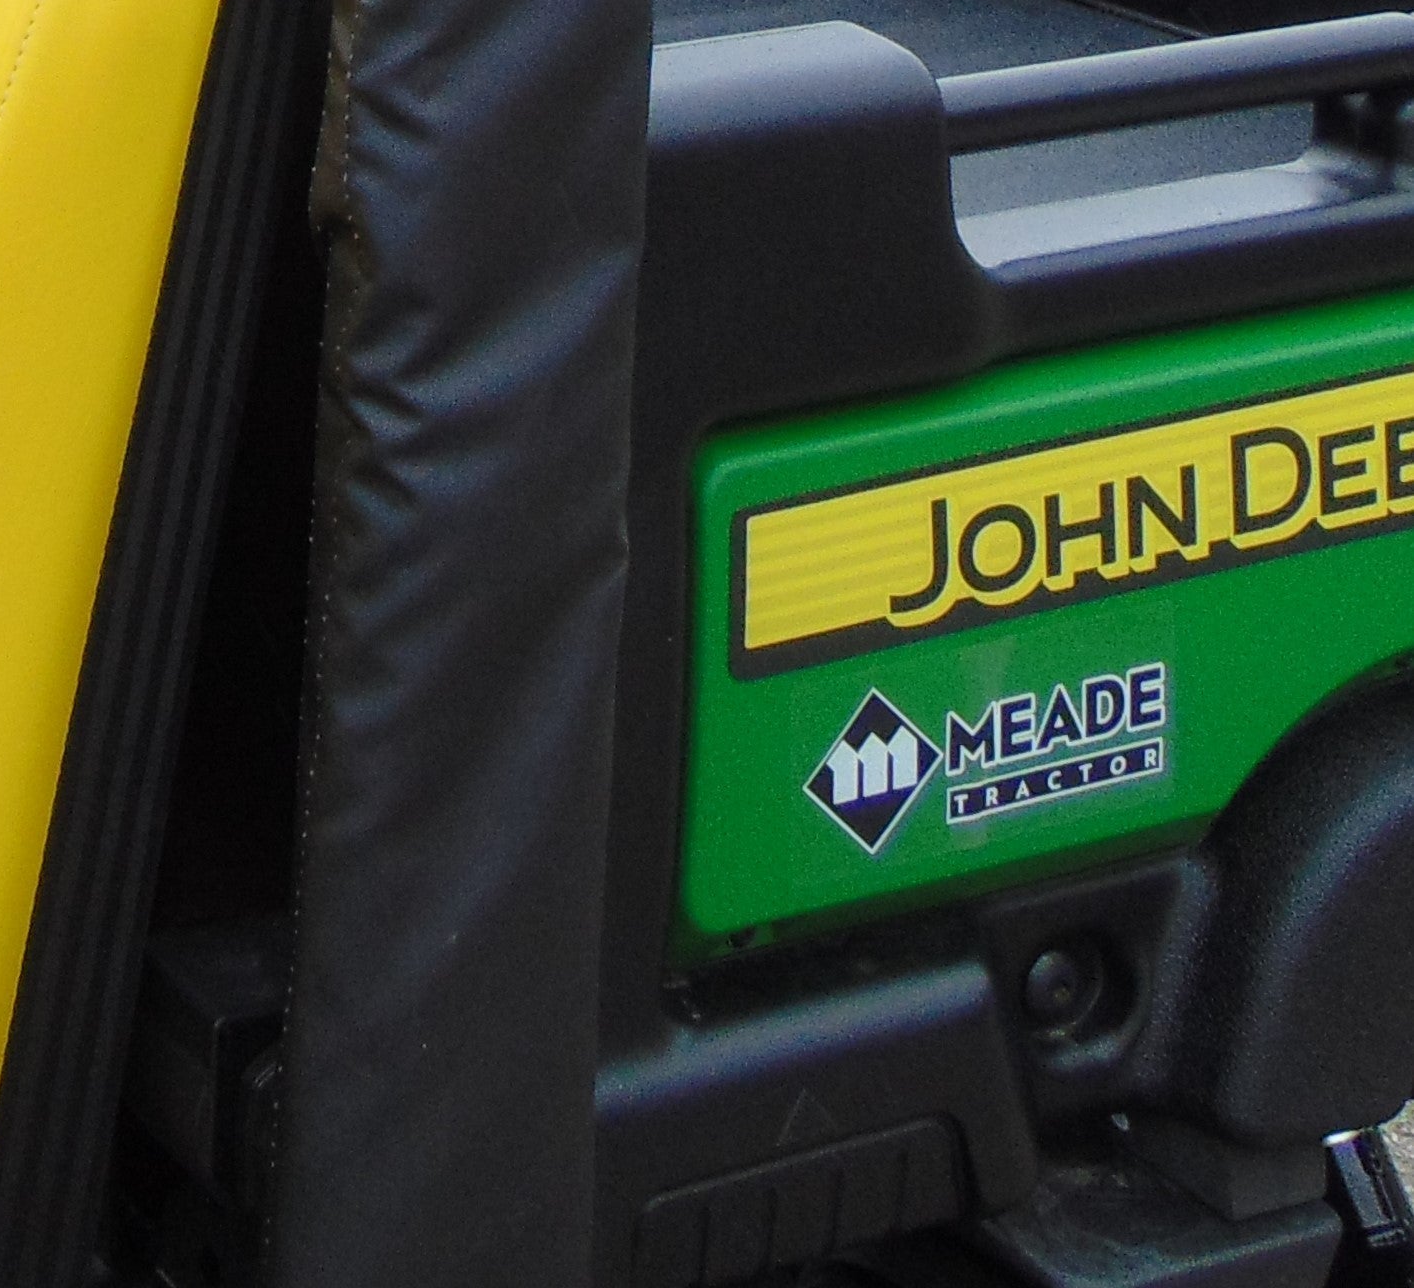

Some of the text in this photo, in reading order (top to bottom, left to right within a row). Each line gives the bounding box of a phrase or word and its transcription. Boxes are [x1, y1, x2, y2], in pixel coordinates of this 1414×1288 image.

[889, 464, 1197, 614] JOHN
[945, 662, 1165, 776] MEADE
[953, 747, 1158, 815] TRACTOR
